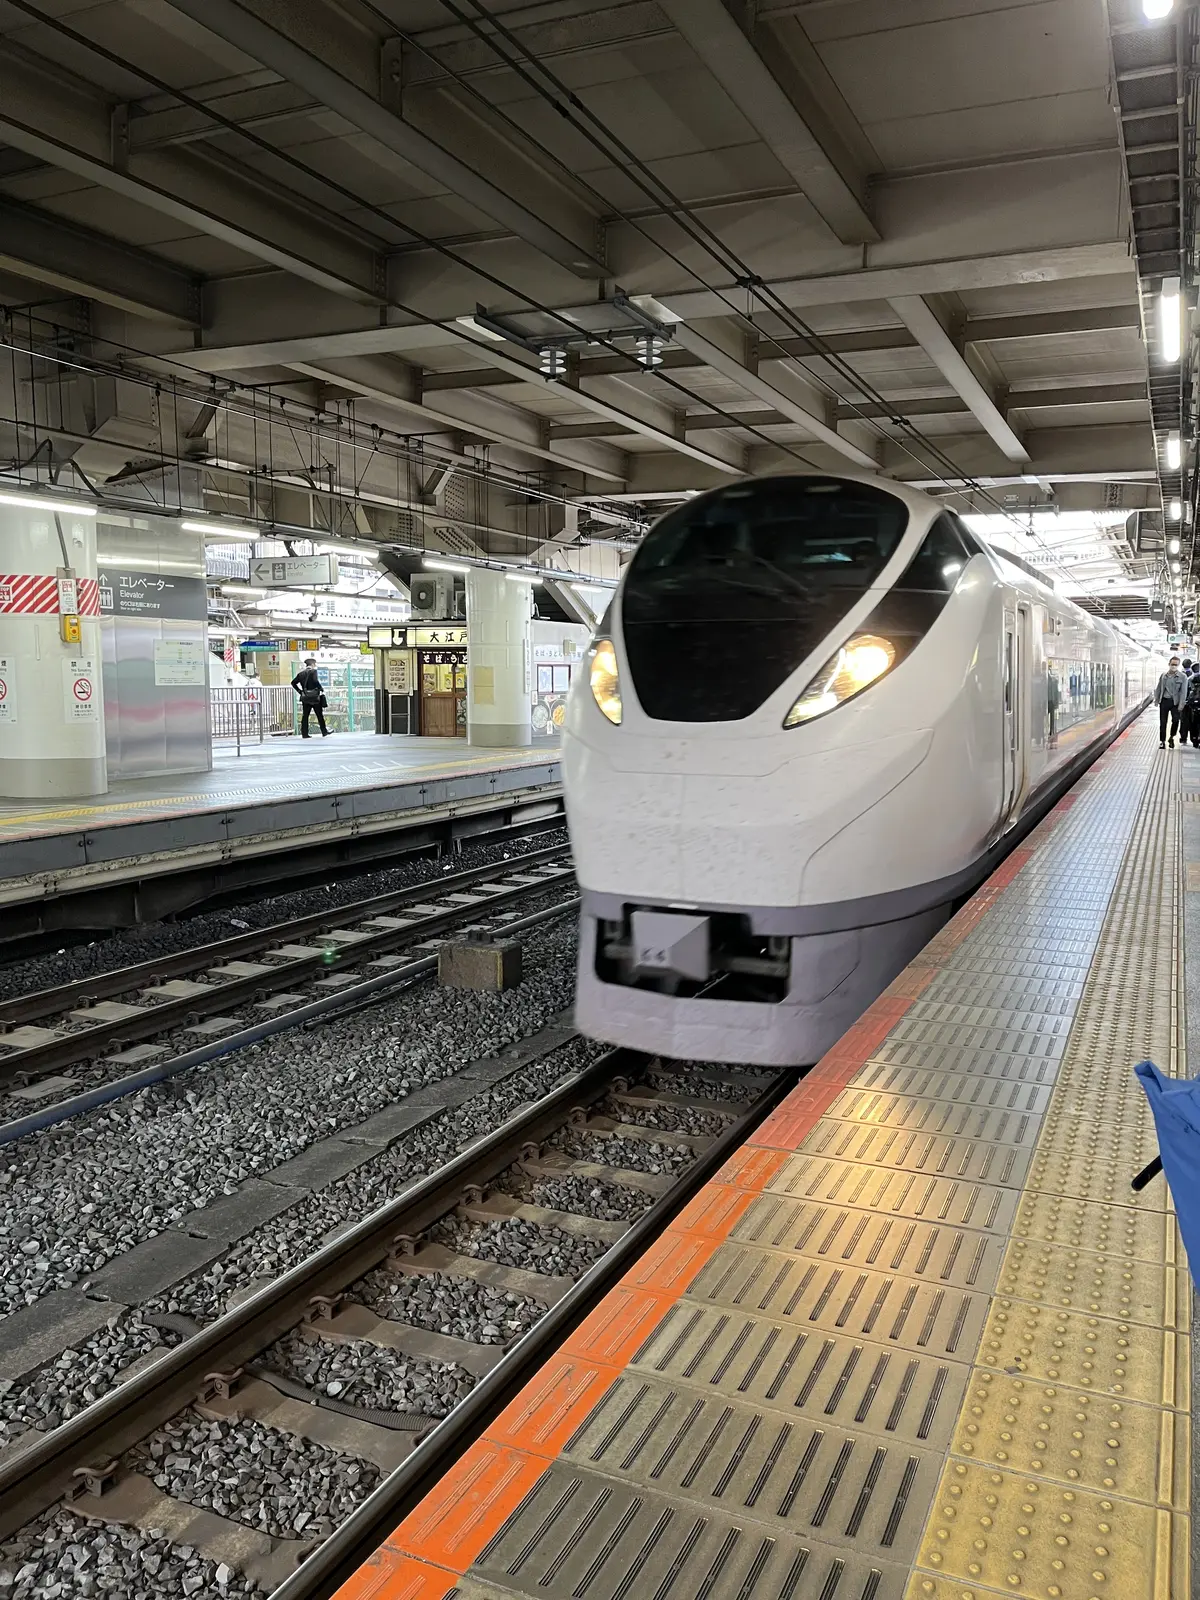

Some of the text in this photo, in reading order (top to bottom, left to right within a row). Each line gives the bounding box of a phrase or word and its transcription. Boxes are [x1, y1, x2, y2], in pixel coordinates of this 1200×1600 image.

[287, 561, 326, 570] エレベーター
[119, 576, 175, 591] エレベーター
[120, 590, 144, 599] Elevator
[429, 631, 467, 643] 大江戸
